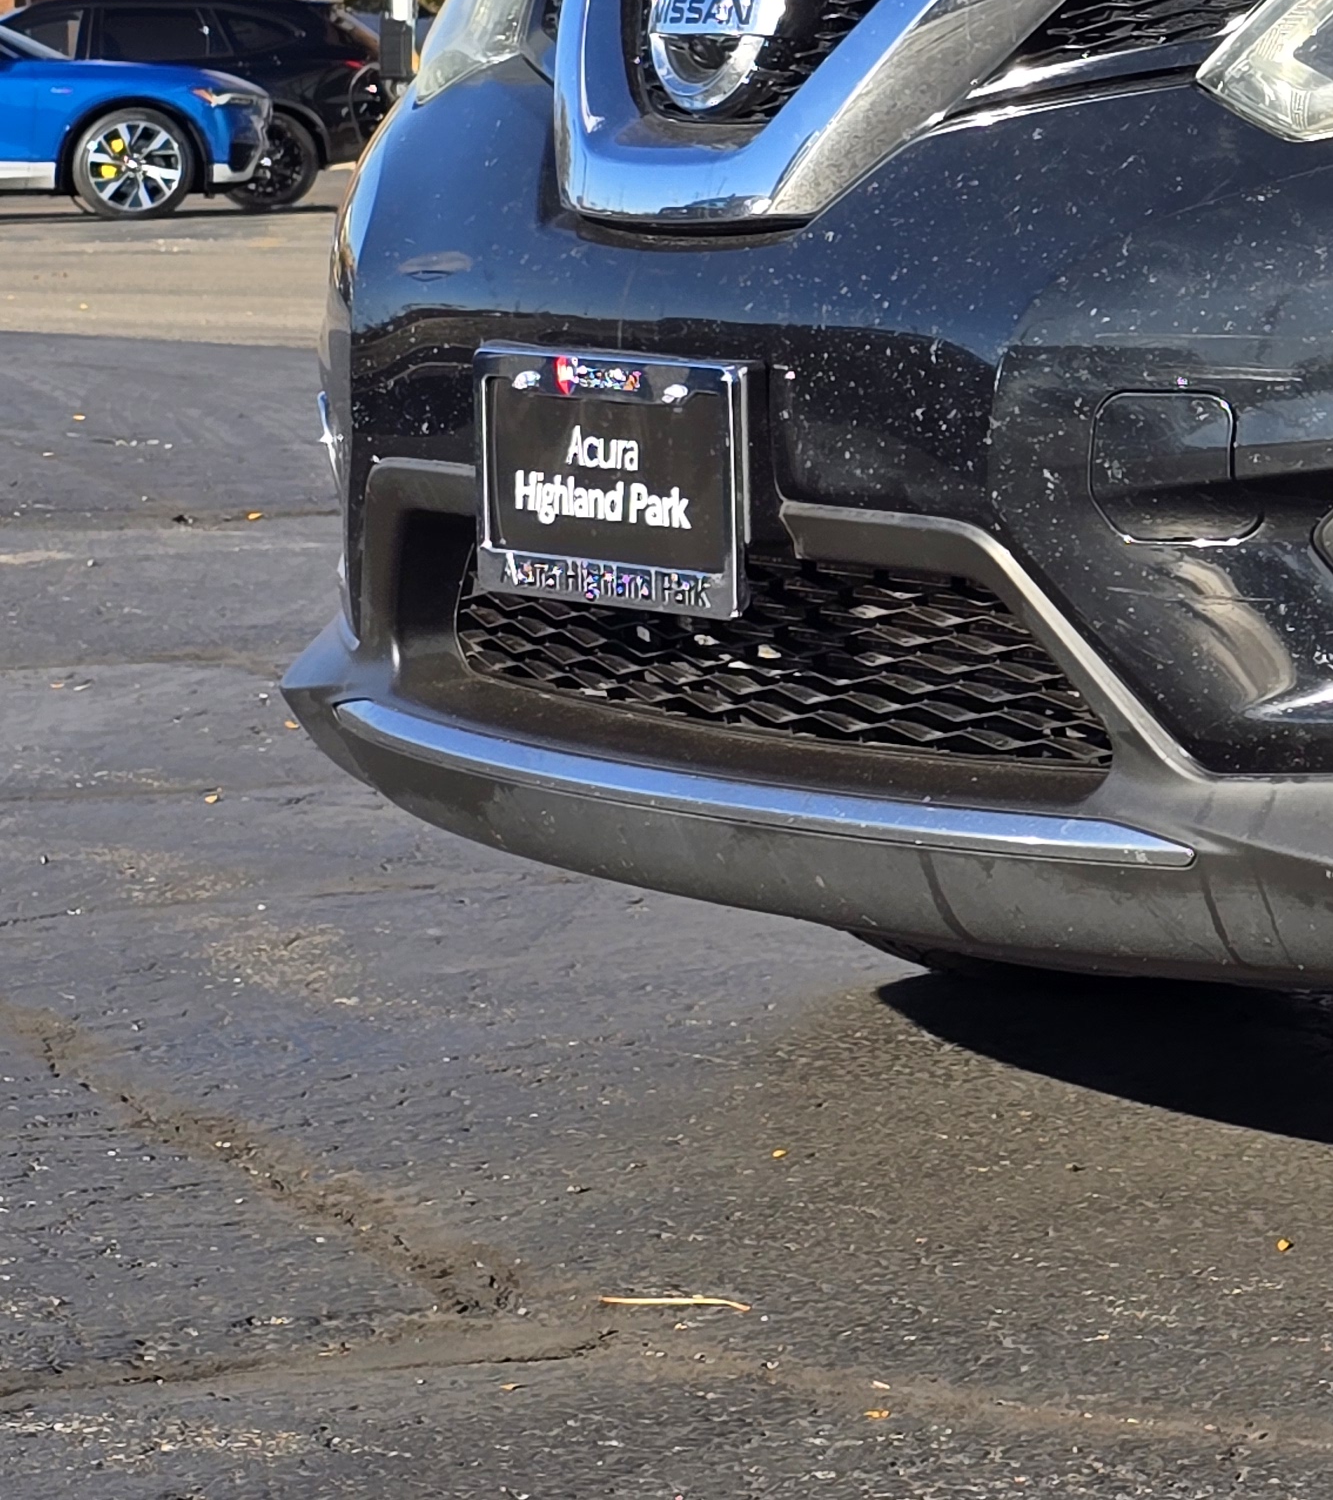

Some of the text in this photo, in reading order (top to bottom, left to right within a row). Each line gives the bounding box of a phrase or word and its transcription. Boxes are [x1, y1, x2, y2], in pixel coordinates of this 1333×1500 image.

[565, 425, 639, 471] Acura
[515, 470, 692, 529] Highland Park
